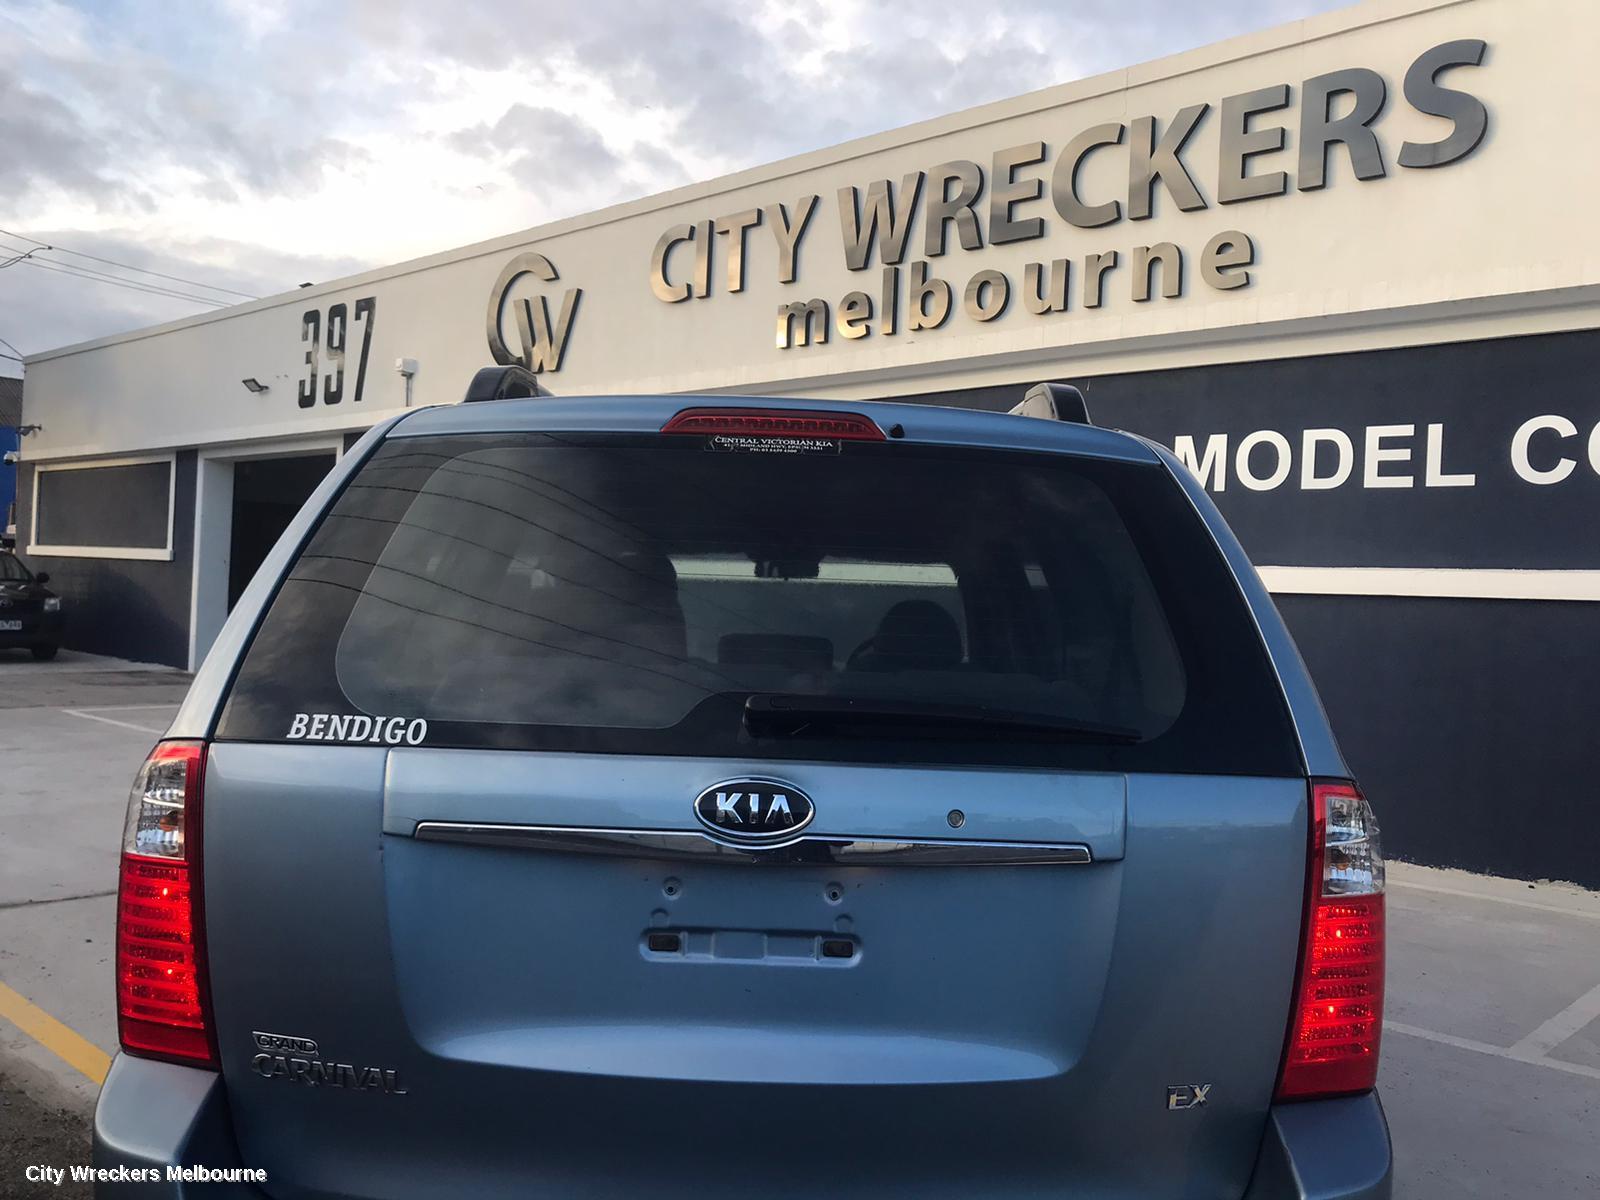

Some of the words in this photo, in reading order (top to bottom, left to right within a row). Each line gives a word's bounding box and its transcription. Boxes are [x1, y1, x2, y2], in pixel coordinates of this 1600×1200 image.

[649, 195, 820, 304] CITY
[841, 39, 1490, 271] WRECKERS
[775, 230, 1256, 350] melbourne
[298, 296, 377, 409] 397
[714, 435, 759, 444] CENTRAL
[761, 438, 815, 447] VICTORIAN
[816, 440, 834, 448] KIA
[1174, 423, 1476, 492] MODEL
[1510, 414, 1600, 485] C
[286, 713, 428, 746] BENDIGO
[714, 791, 793, 826] KIA
[256, 1034, 318, 1054] GRAND
[252, 1053, 408, 1095] CARNIVAL
[1167, 1083, 1212, 1110] EX
